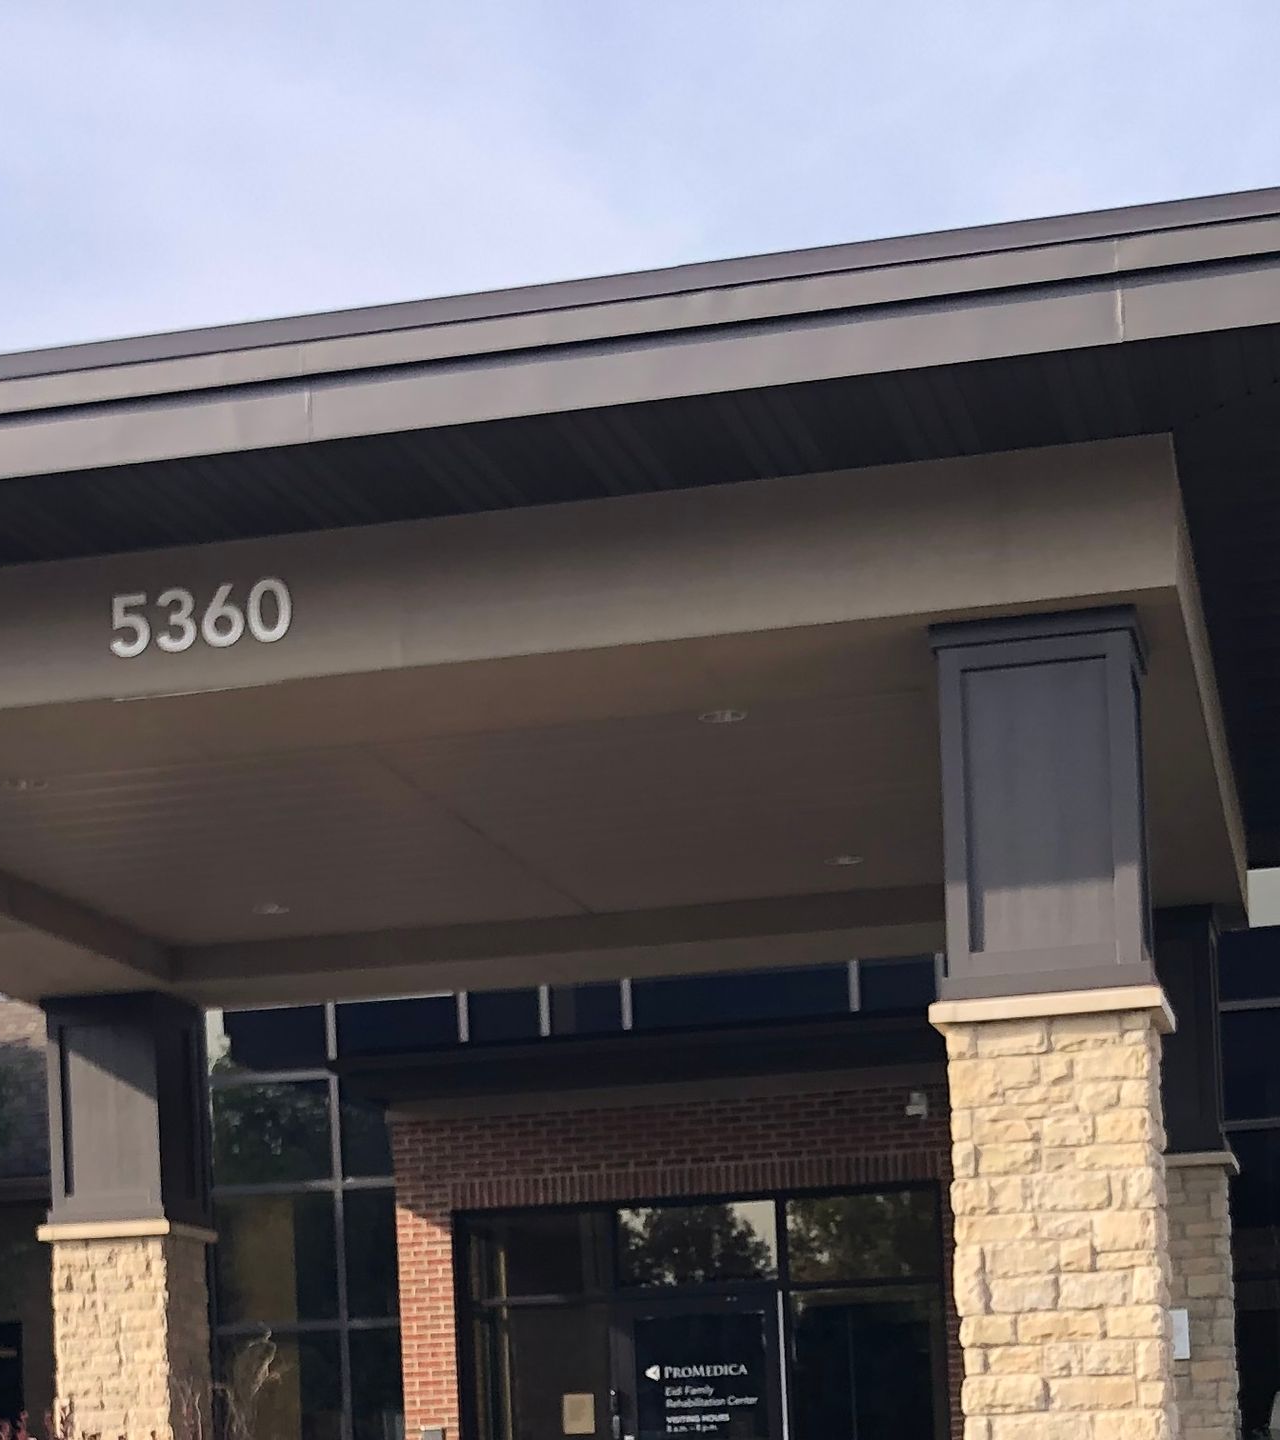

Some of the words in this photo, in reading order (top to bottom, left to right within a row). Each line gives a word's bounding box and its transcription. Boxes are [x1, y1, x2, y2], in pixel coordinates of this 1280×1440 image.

[109, 577, 292, 658] 5360
[685, 1384, 715, 1397] Family
[665, 1397, 726, 1408] Rehabilitation
[727, 1395, 759, 1406] Center
[702, 1413, 730, 1422] HOURS
